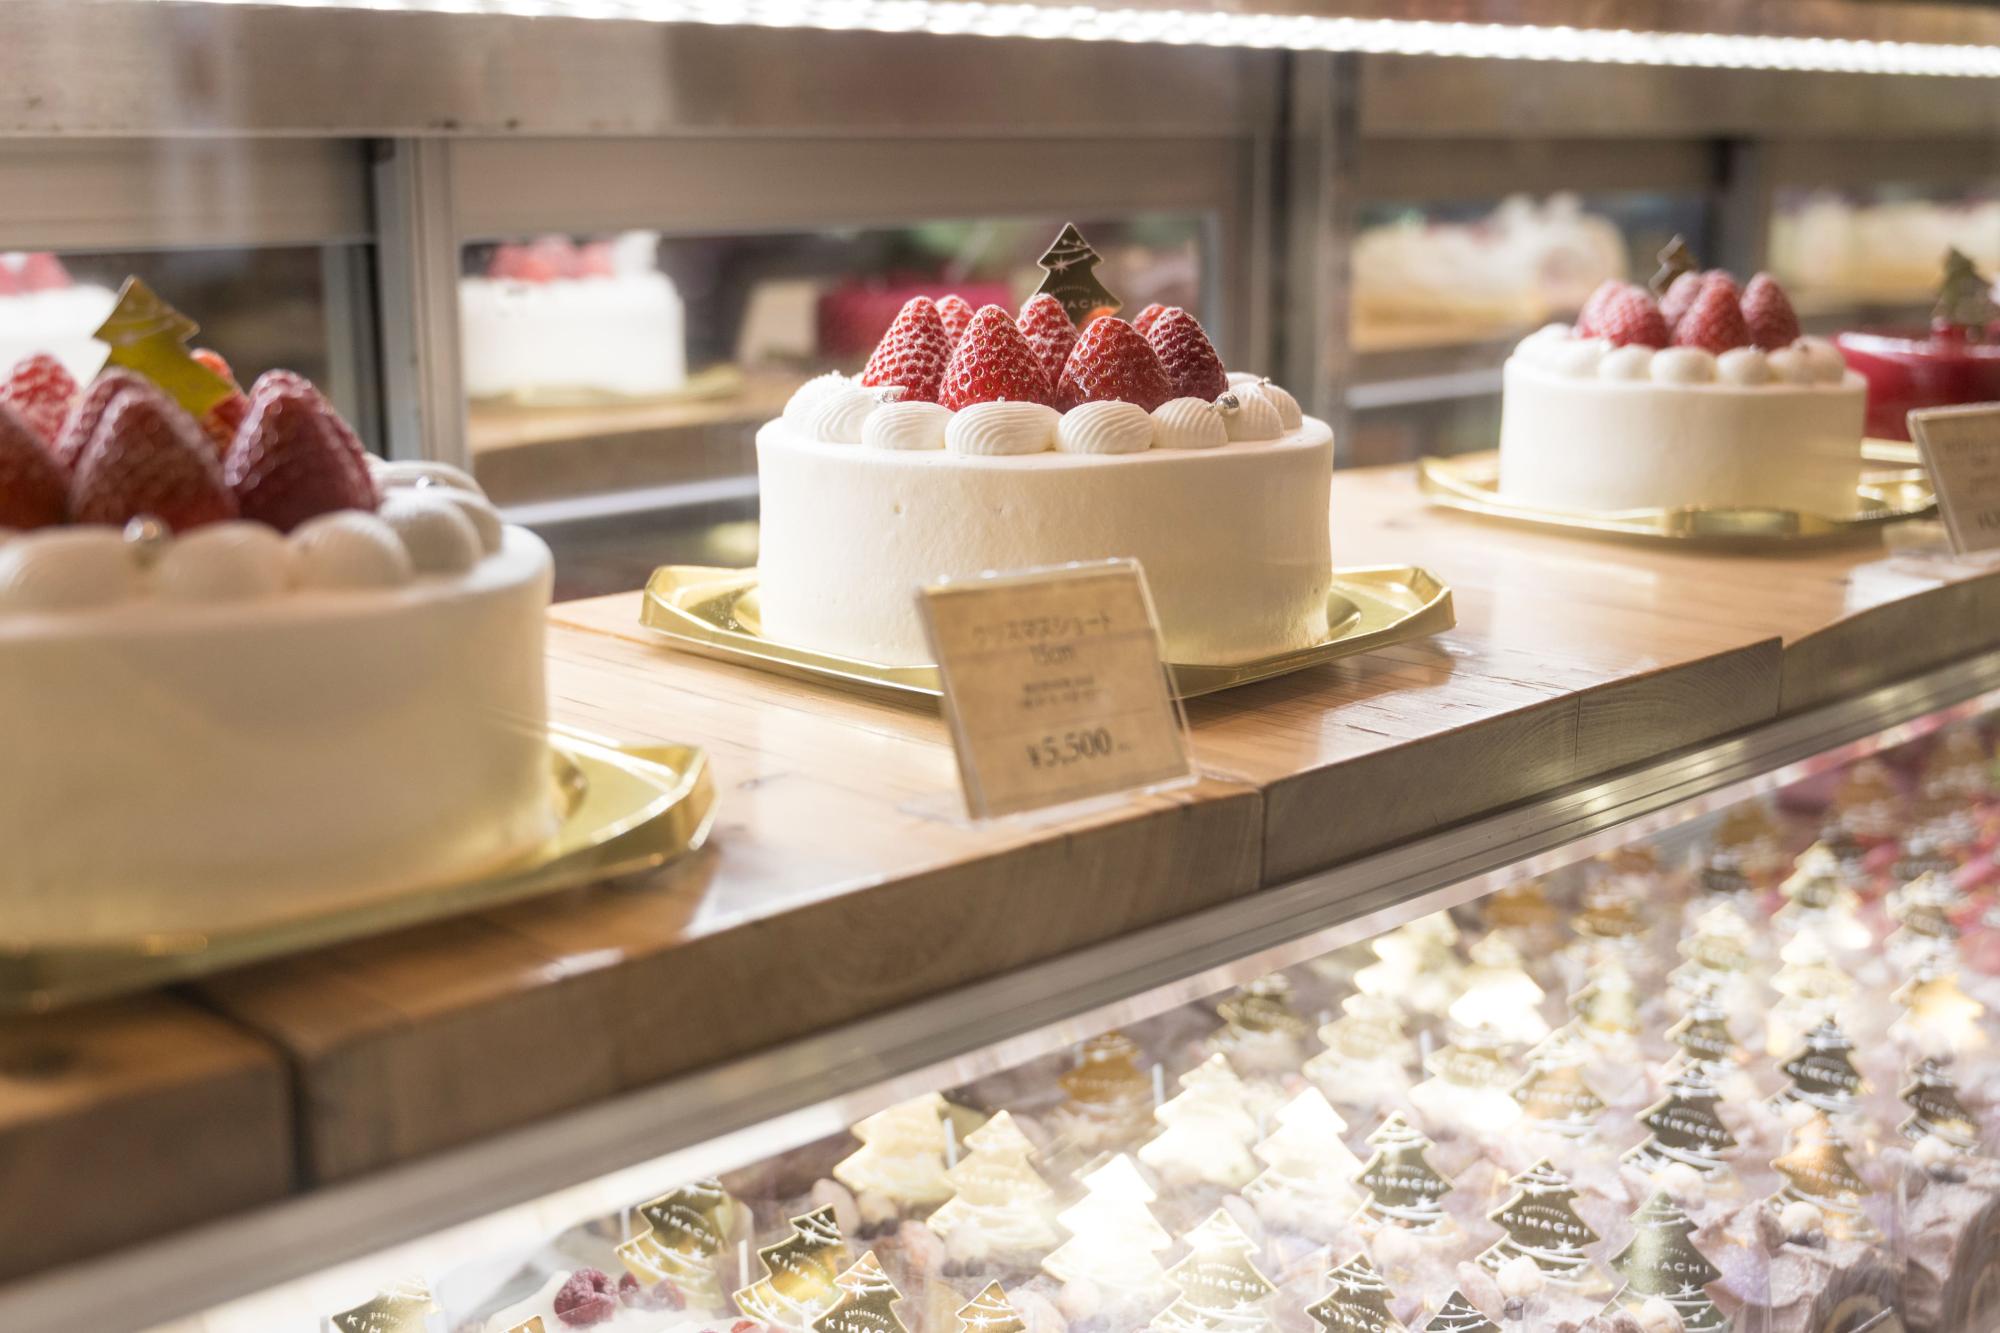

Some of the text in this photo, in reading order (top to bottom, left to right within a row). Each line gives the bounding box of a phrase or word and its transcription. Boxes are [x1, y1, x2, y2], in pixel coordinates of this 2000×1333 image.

[1025, 727, 1113, 769] ¥5,500
[1363, 1174, 1447, 1192] KIHACHI
[1502, 1211, 1590, 1239] KIHACHI
[1623, 1256, 1709, 1275] KHACHI
[1177, 1271, 1266, 1294] KIHACHI
[844, 1308, 889, 1326] patisserie
